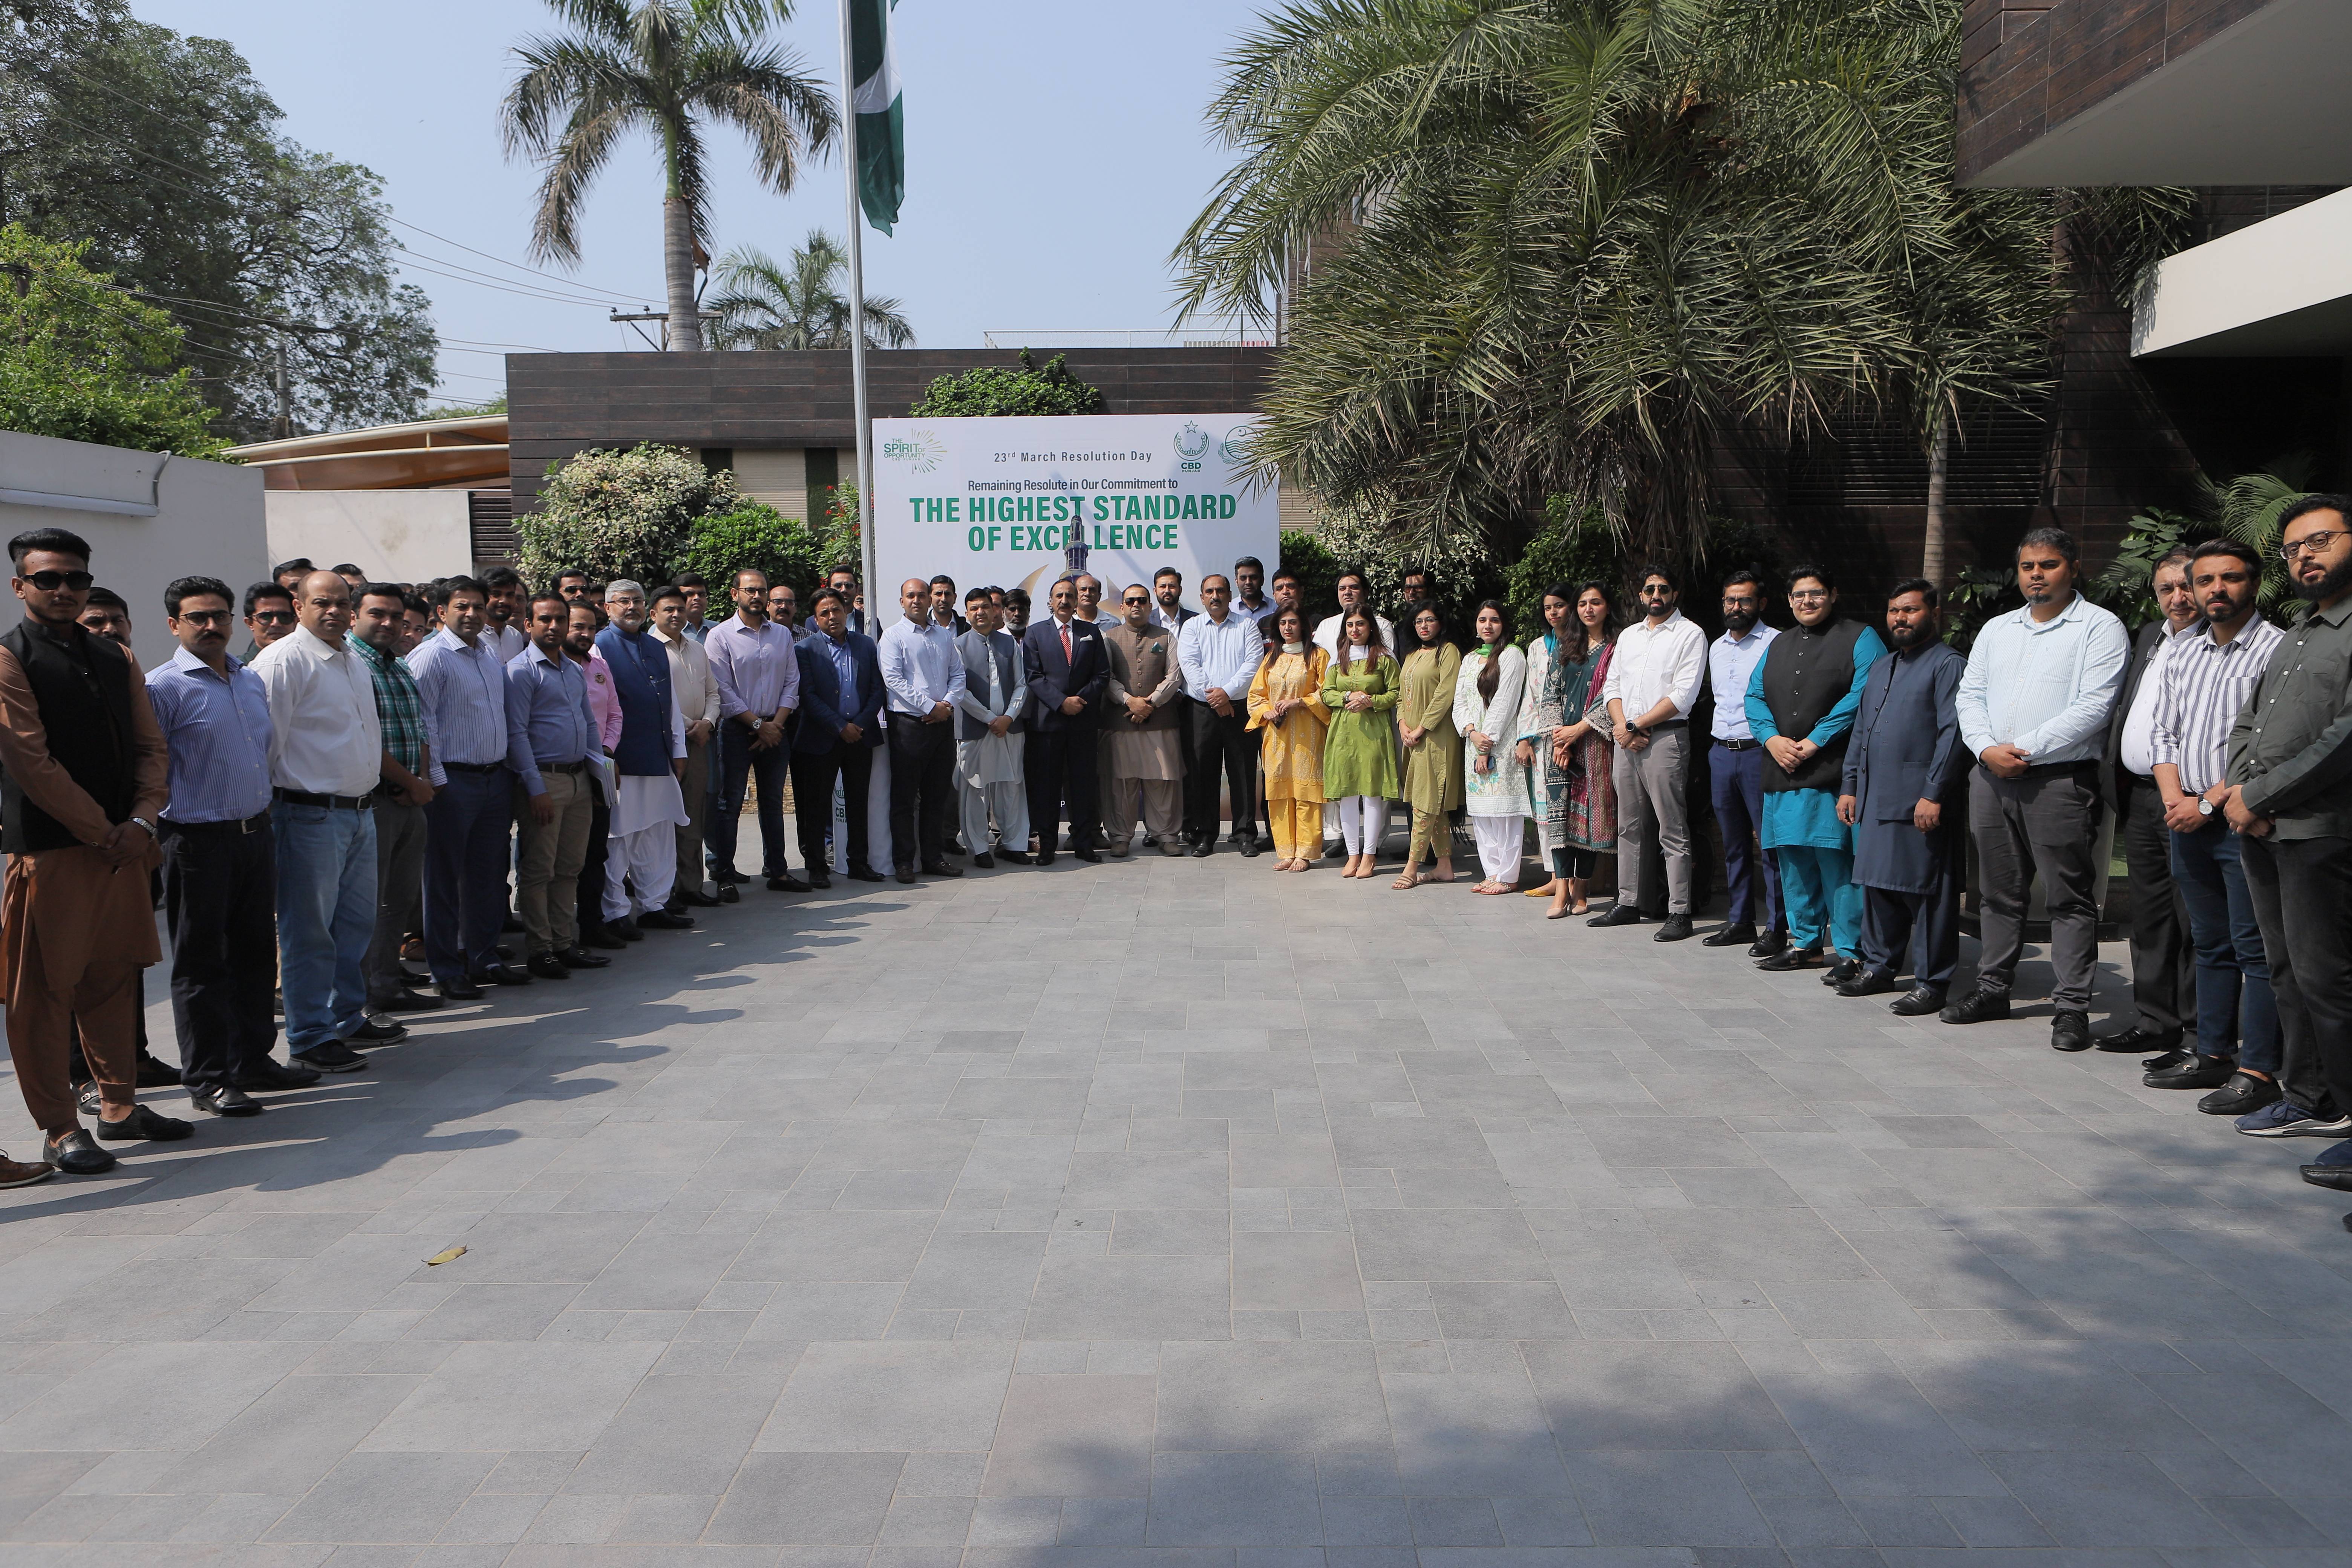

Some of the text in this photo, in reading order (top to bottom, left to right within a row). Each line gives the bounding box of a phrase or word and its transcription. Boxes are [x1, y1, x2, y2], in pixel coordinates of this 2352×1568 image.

[884, 443, 920, 453] SPIRIT
[994, 451, 1152, 462] 23rd March Resolution Day
[968, 478, 1178, 493] Remaining Resolute in Our Commitment to
[910, 495, 1236, 522] THE HIGHEST STANDARD
[968, 527, 1001, 551] OF
[836, 807, 845, 818] CB
